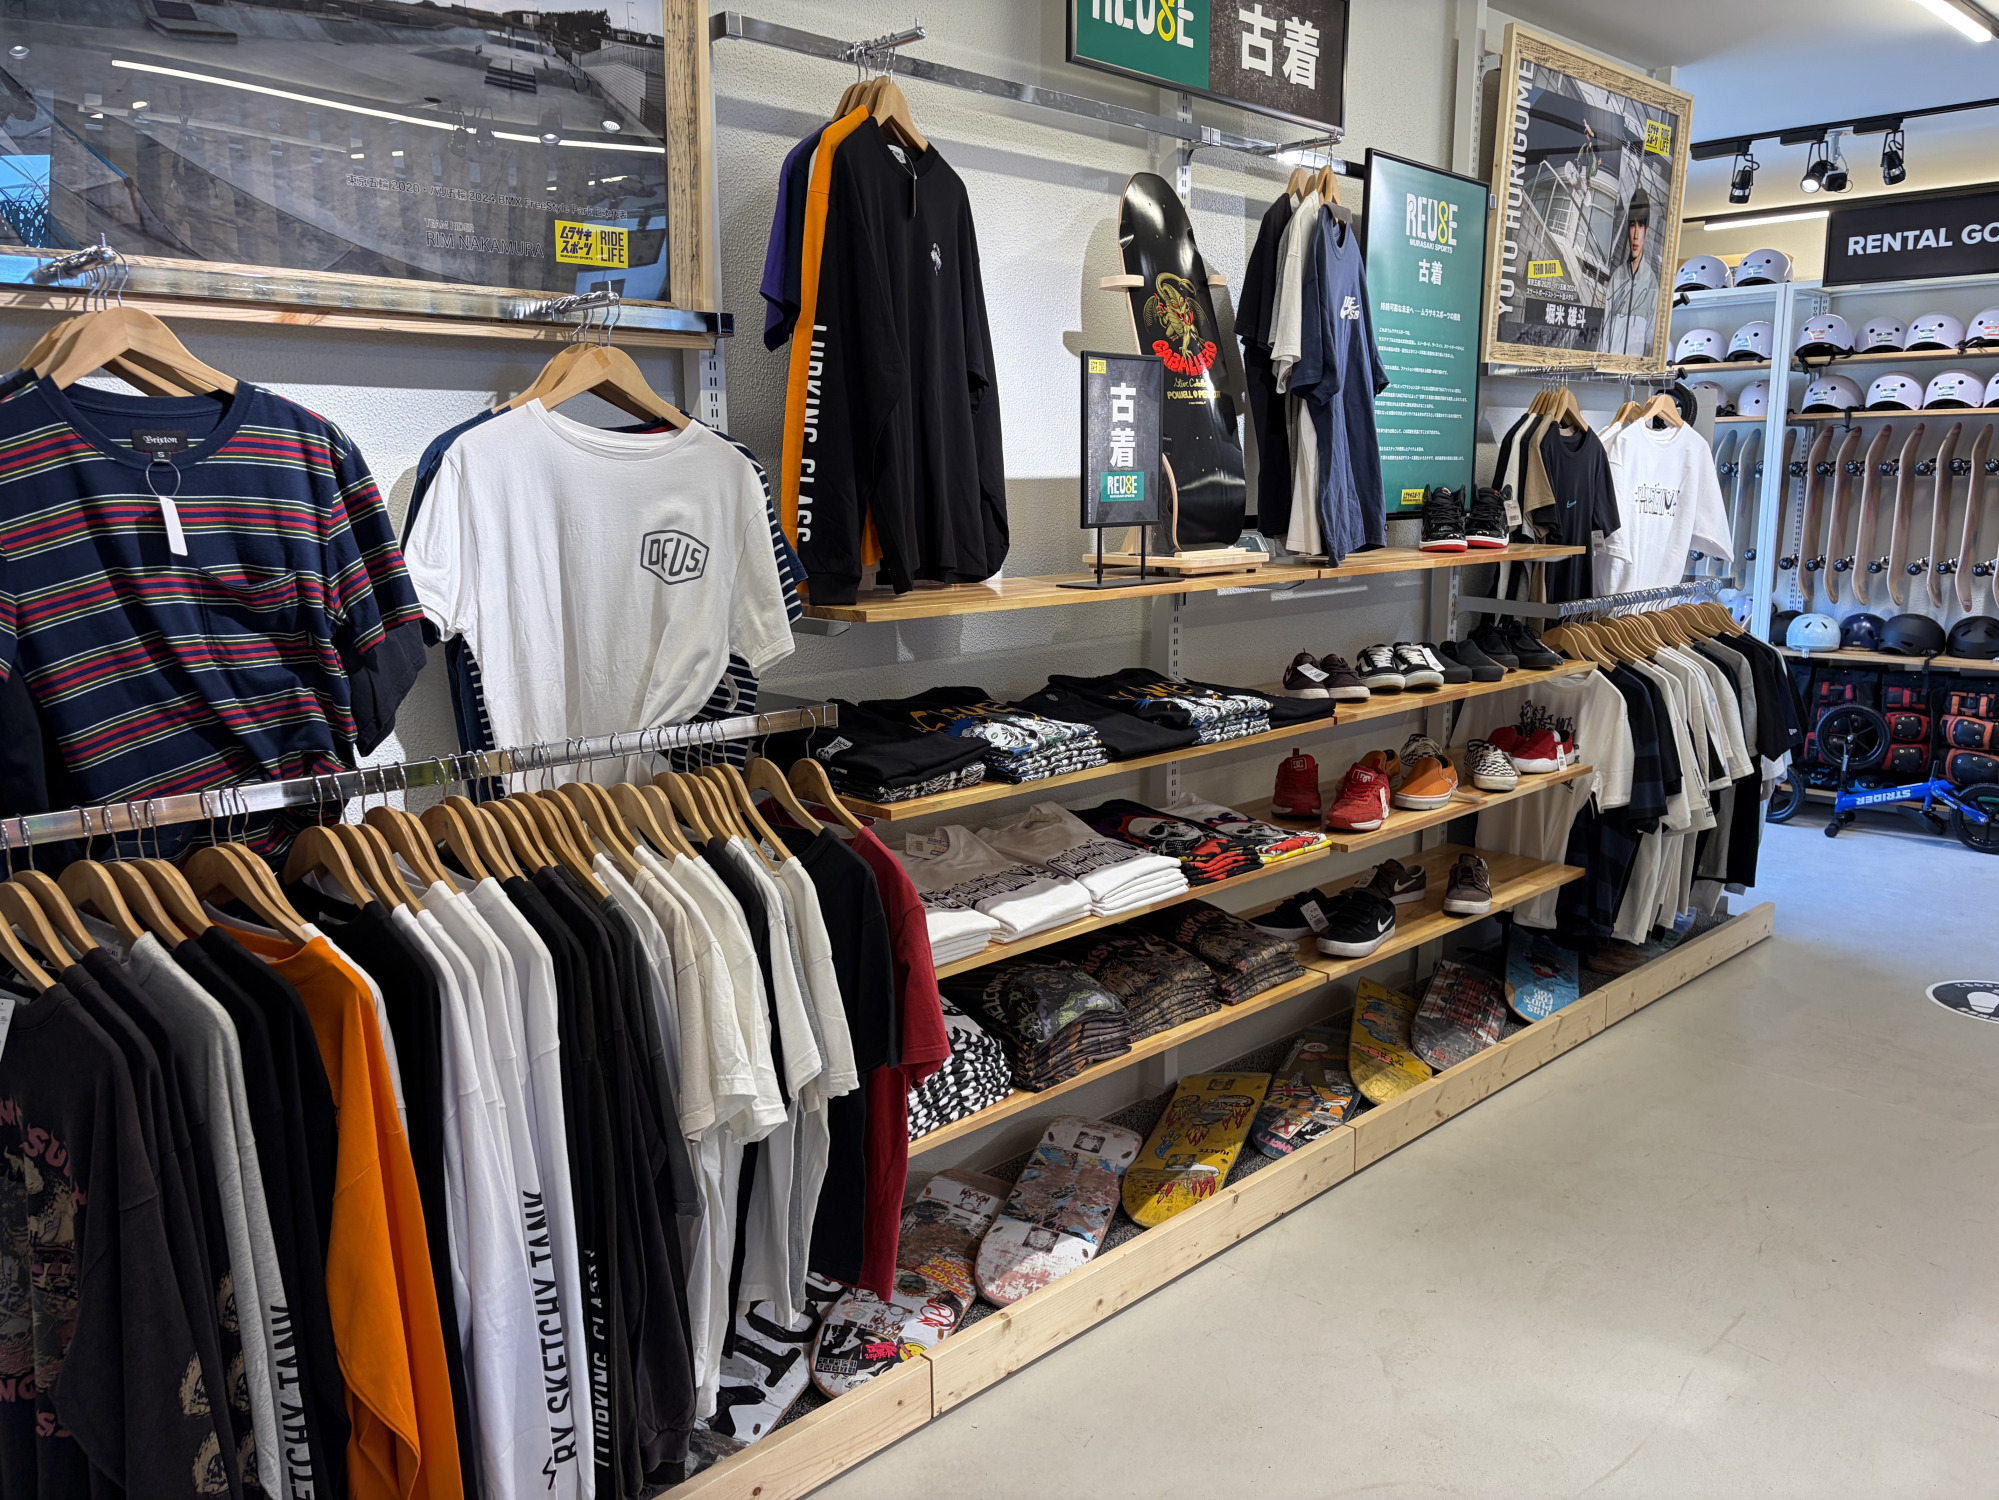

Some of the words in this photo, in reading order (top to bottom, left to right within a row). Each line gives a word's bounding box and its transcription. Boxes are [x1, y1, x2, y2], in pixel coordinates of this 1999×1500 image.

[1239, 4, 1320, 90] 古着
[1506, 61, 1535, 231] HORIGOME
[468, 190, 497, 204] 2024
[498, 195, 523, 208] BMX
[571, 203, 594, 217] Park
[424, 217, 449, 230] TEAM
[450, 220, 475, 233] RIDER
[560, 225, 593, 242] ムラサキ
[426, 231, 455, 249] RIM
[458, 234, 546, 259] NAKAMURA
[560, 239, 594, 256] スポーツ
[600, 229, 625, 248] RIDE
[1409, 238, 1435, 250] MURASAKI
[1435, 242, 1453, 254] SPORTS
[1847, 227, 1953, 256] RENTAL
[600, 245, 625, 264] LIFE
[1418, 258, 1443, 286] 古着
[1498, 241, 1519, 316] YUTO
[1545, 302, 1566, 326] 堀米
[1152, 340, 1218, 376] CABALLERO
[1167, 390, 1194, 400] POWELL
[1109, 382, 1137, 468] 古着
[142, 435, 178, 445] Brixton
[648, 537, 702, 577] DEUS
[1856, 789, 1912, 806] STRIDER
[1534, 993, 1554, 1005] FOR
[1527, 1004, 1550, 1017] THIS
